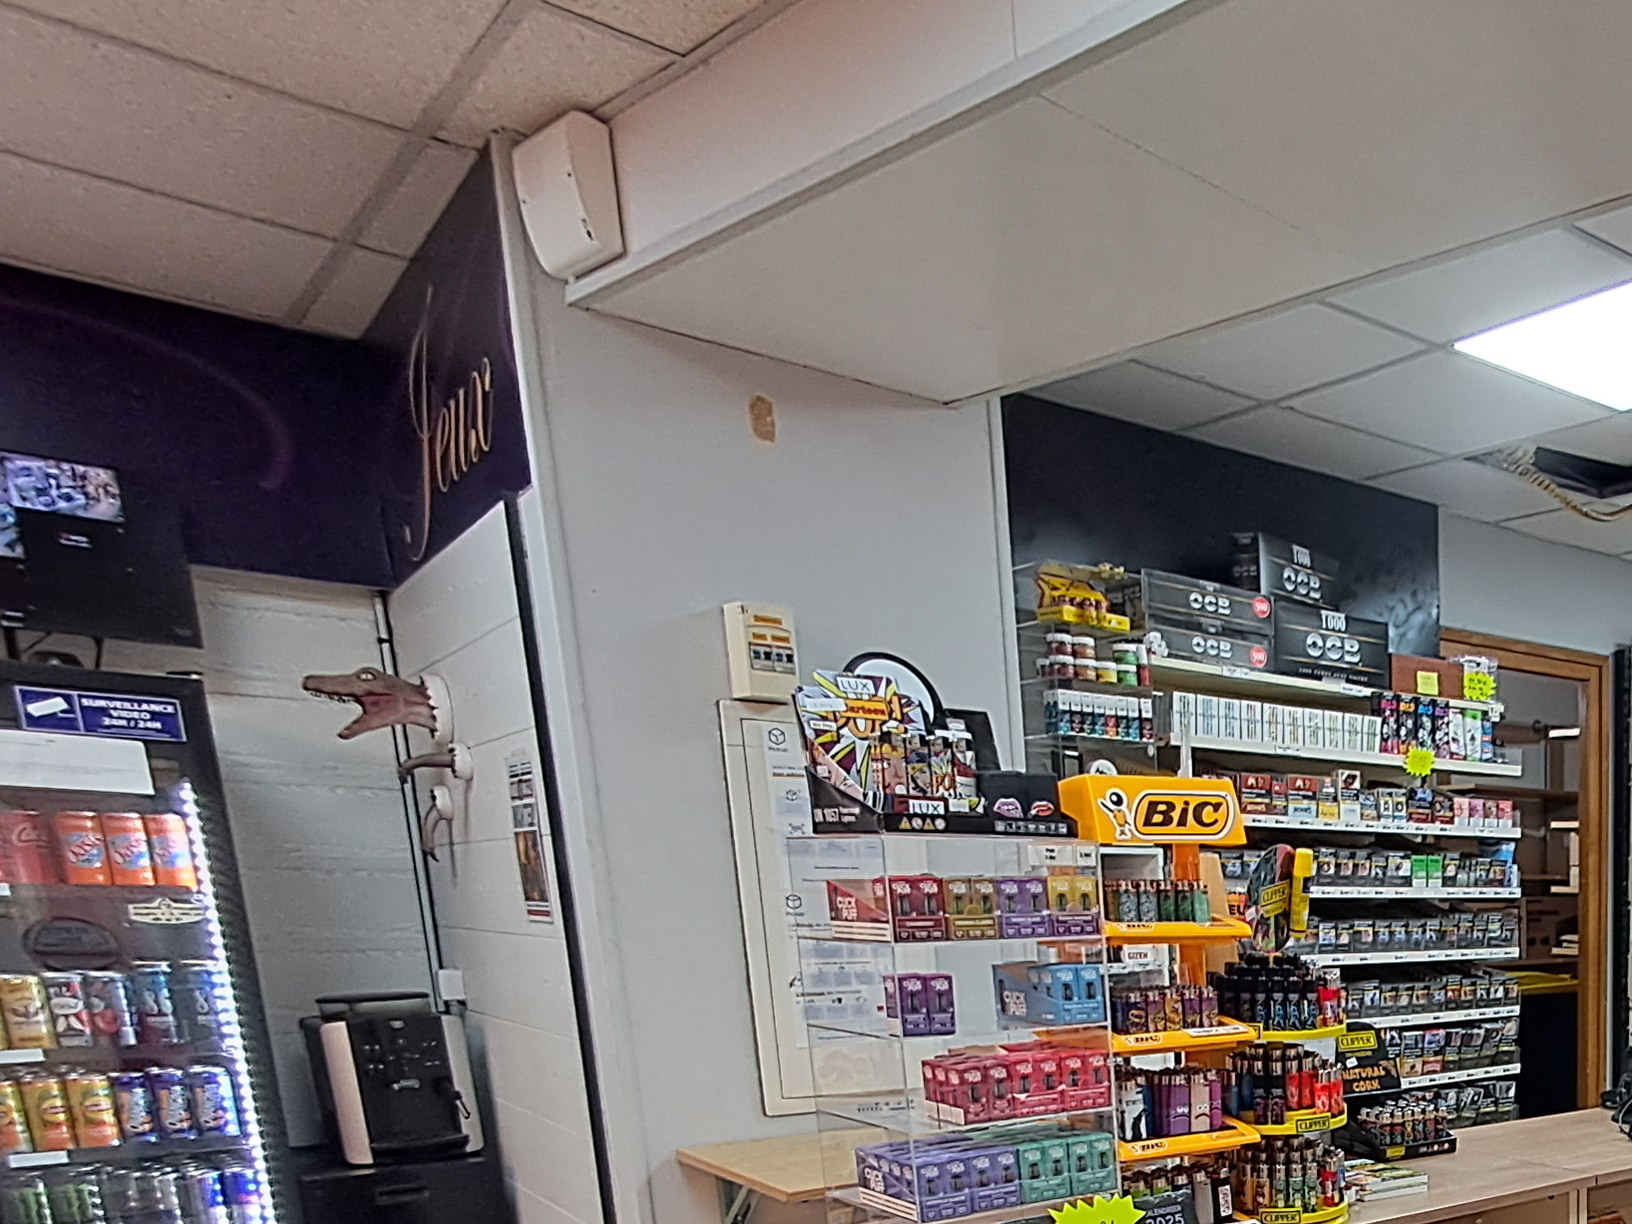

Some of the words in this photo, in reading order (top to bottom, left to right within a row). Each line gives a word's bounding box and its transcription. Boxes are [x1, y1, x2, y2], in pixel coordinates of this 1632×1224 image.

[1283, 567, 1322, 600] OCB
[1190, 592, 1231, 615] OCB
[1321, 610, 1346, 632] 1000
[1191, 636, 1232, 658] OCB
[1306, 632, 1361, 664] OCB
[841, 679, 872, 692] LUX
[81, 698, 175, 713] SURVEILLANCE
[109, 710, 151, 720] VIDEO
[912, 802, 941, 814] LUX
[1340, 1033, 1374, 1047] CLIPPER
[1342, 1067, 1385, 1080] NATURAL
[1353, 1079, 1380, 1092] CORK
[1299, 1119, 1328, 1132] CLIPPER
[1264, 1211, 1298, 1224] CLIPPER
